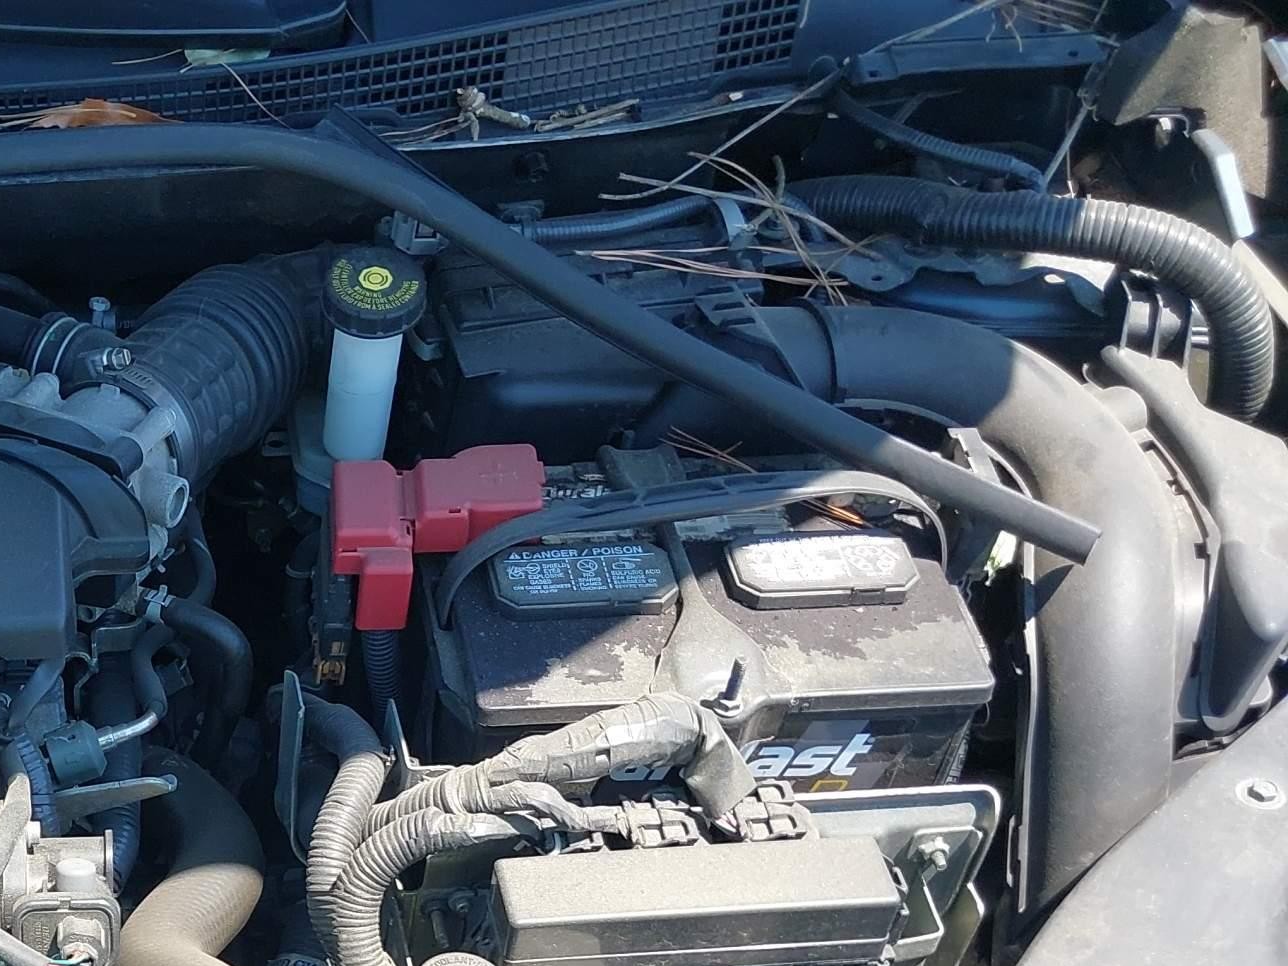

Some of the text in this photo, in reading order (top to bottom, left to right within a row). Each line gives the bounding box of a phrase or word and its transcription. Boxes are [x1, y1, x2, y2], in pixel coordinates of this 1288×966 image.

[522, 545, 643, 560] DANGER / POISON
